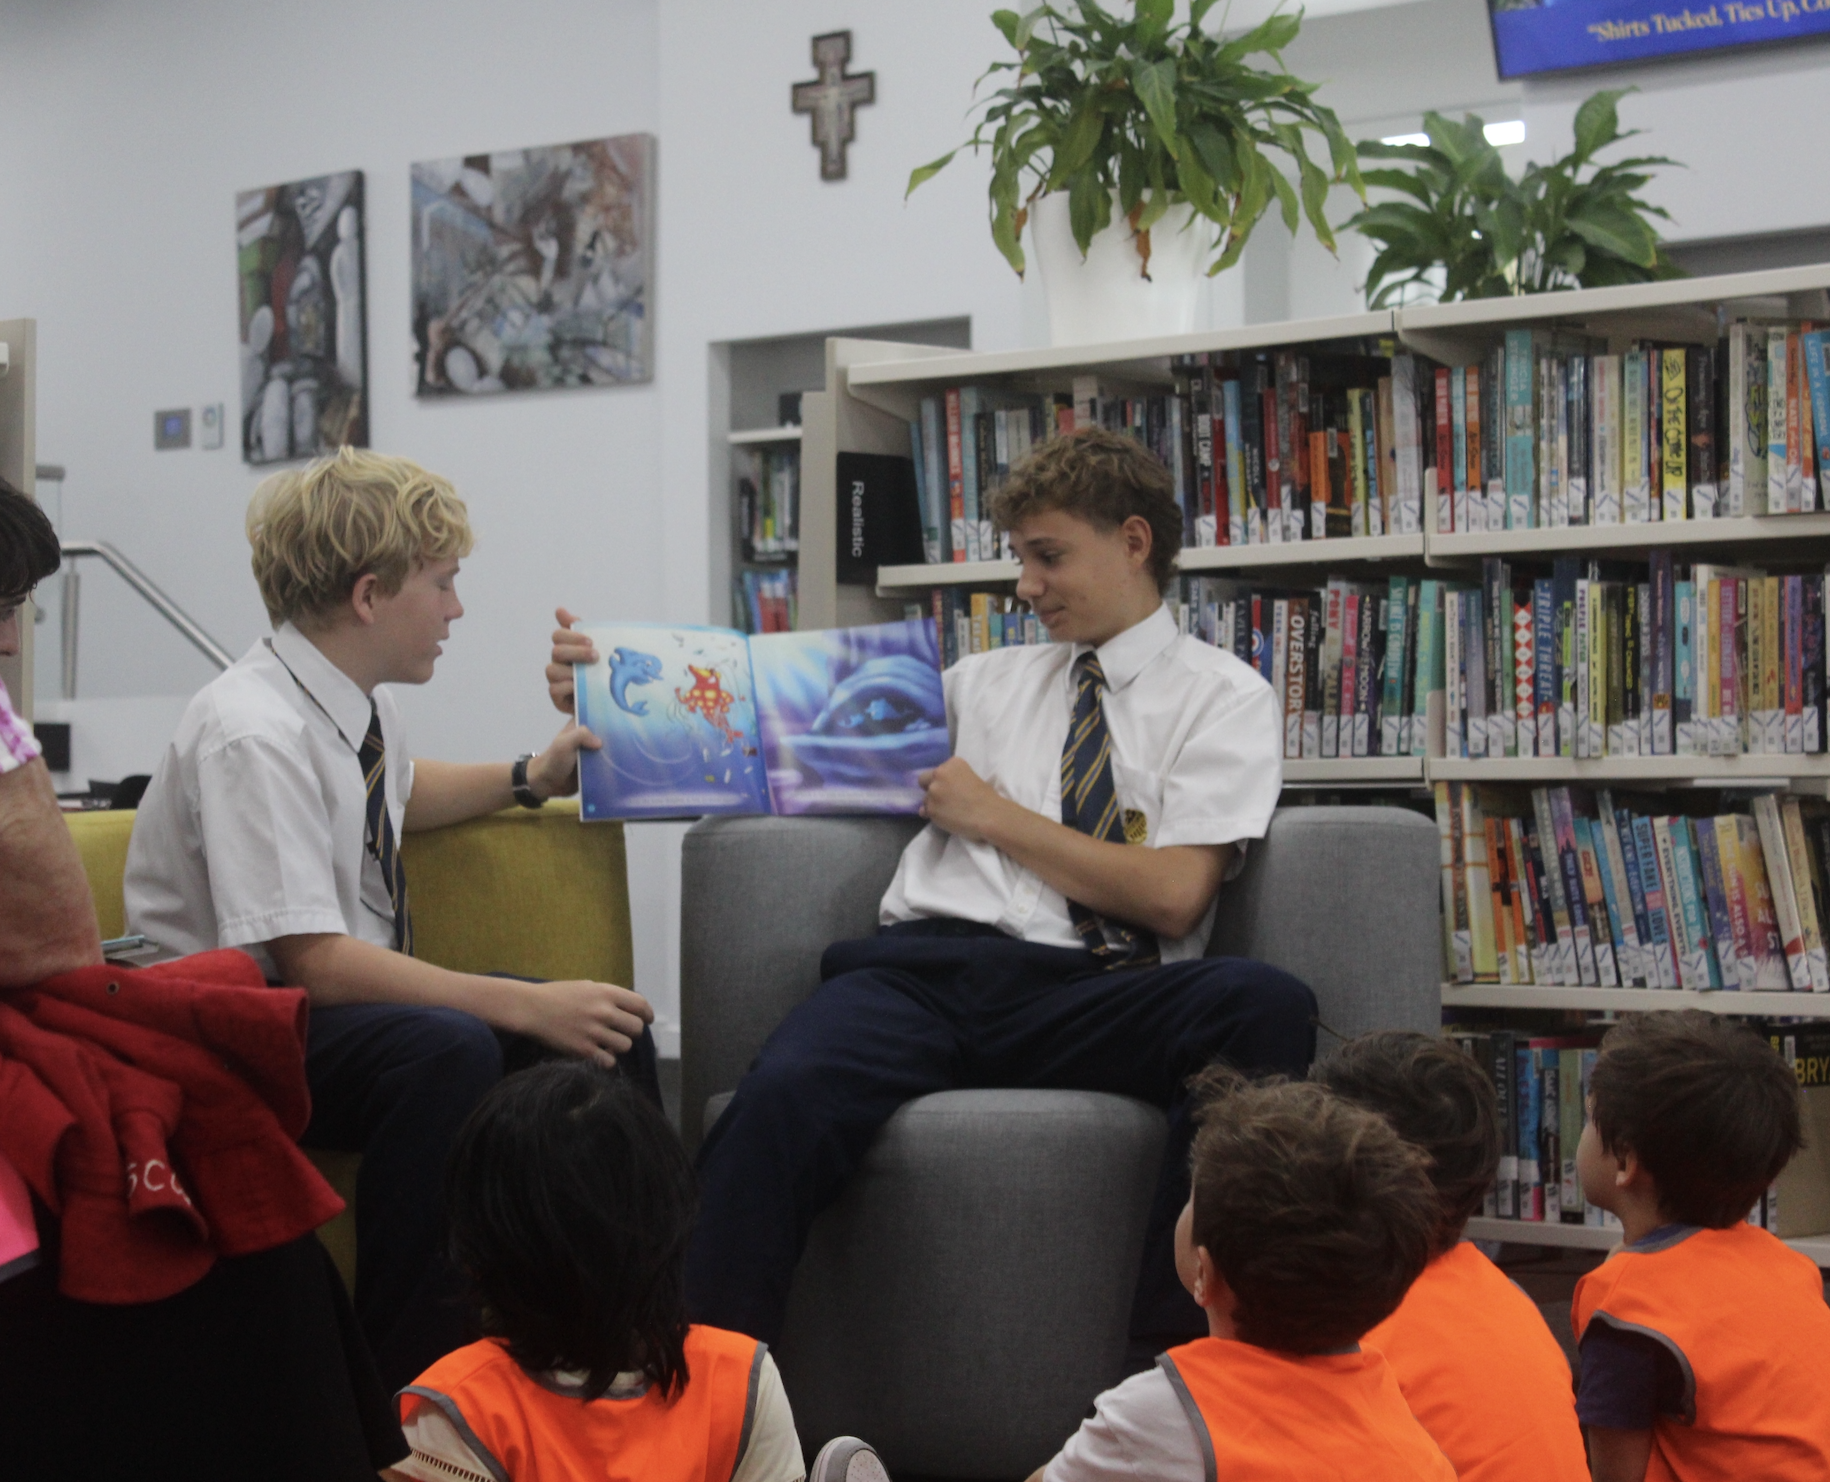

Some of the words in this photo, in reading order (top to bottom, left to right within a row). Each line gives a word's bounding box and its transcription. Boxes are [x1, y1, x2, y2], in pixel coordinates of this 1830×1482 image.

[1724, 2, 1765, 24] Ties
[1807, 339, 1819, 364] LIFE
[1814, 381, 1822, 389] A
[1788, 398, 1798, 427] NATE
[851, 480, 866, 558] Realistic
[1274, 604, 1283, 634] TEEN
[1328, 589, 1341, 630] PONY
[1537, 587, 1553, 639] TRIPLE
[1358, 663, 1369, 702] MOON
[1539, 645, 1554, 698] THREAT
[1634, 822, 1654, 861] SUPER
[1564, 851, 1576, 877] THEY
[1641, 860, 1660, 891] FAKE
[1662, 845, 1681, 914] EVERYTHING,
[1726, 861, 1739, 888] SUN
[1731, 888, 1741, 901] IS
[1650, 909, 1667, 938] LOVE
[1686, 904, 1699, 924] FOR
[1732, 903, 1746, 936] ALSO
